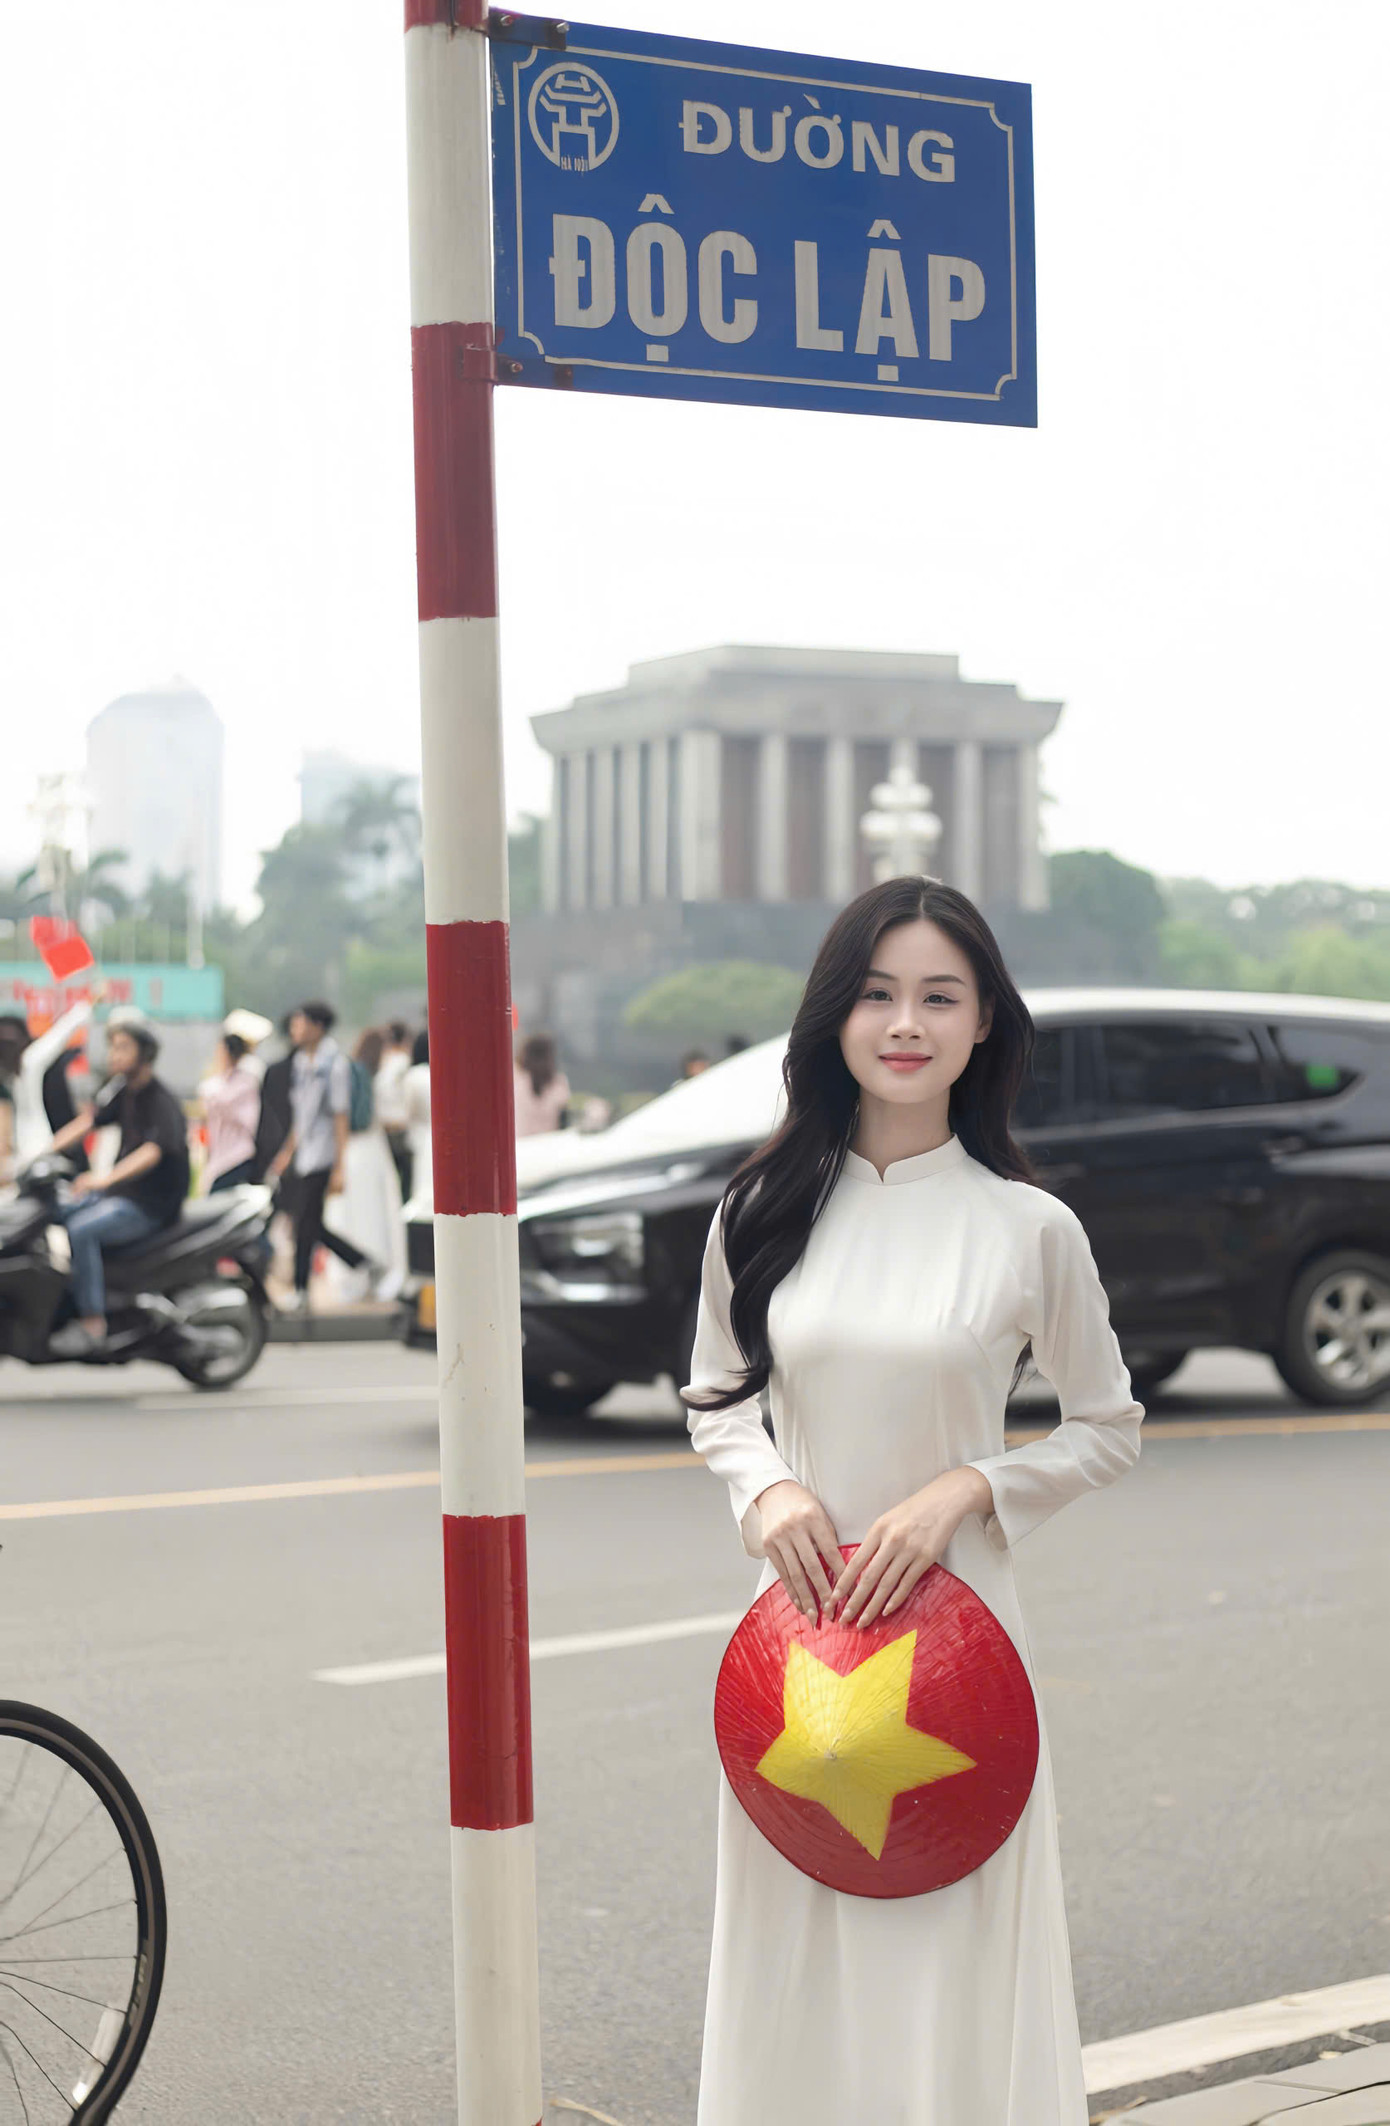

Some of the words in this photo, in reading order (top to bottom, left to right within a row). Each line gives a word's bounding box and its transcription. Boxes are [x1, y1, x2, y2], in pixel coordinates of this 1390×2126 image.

[678, 93, 956, 183] ĐƯỜNG
[549, 193, 759, 362] ĐỘC
[794, 219, 986, 382] LẬP
